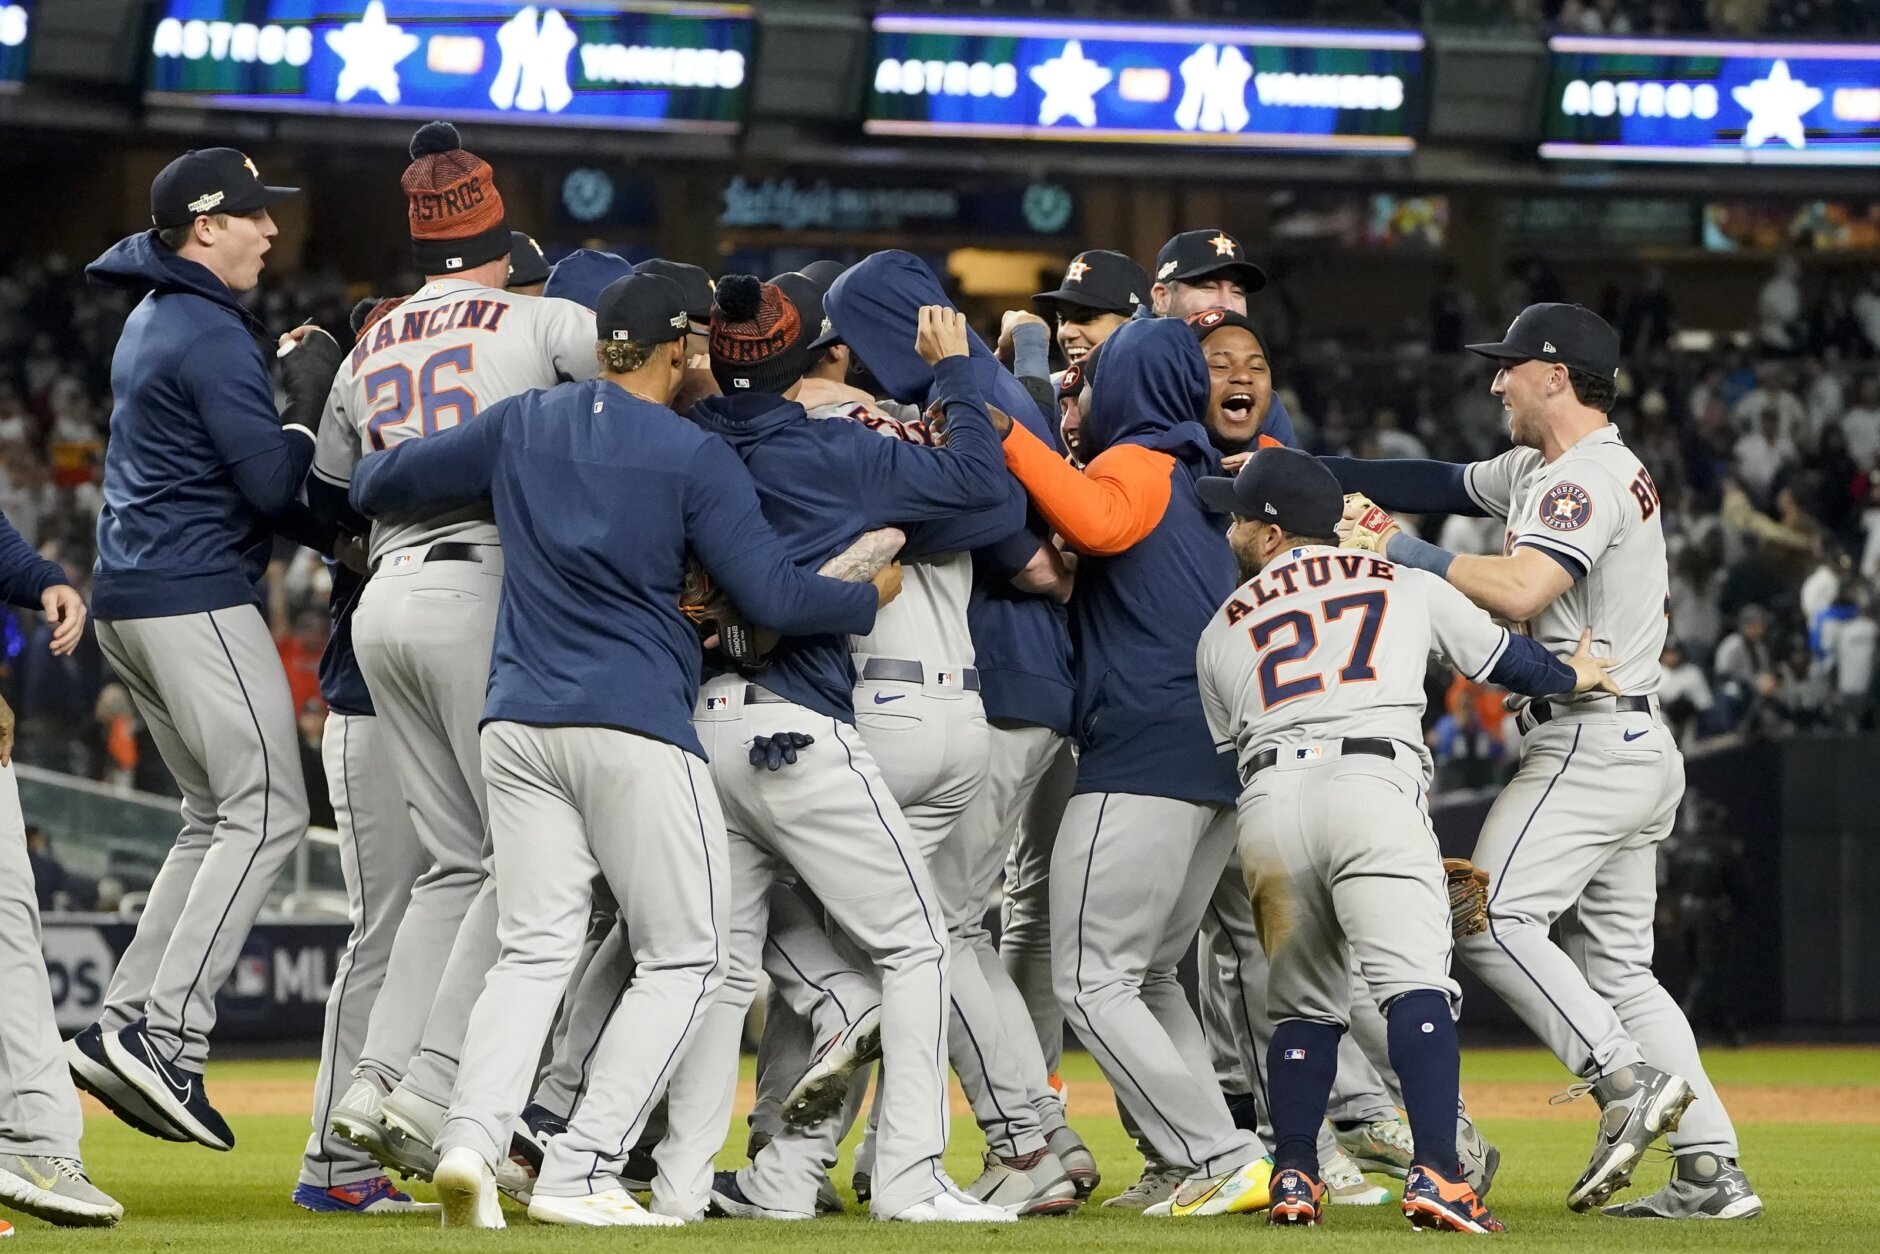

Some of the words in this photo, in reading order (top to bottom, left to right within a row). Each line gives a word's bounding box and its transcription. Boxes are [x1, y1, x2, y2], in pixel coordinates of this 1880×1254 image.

[154, 18, 311, 64] ASTROS
[875, 58, 1016, 97] ASTROS
[1562, 80, 1718, 119] ASTROS
[410, 176, 486, 221] ASTROS
[350, 299, 510, 379] MANCINI
[363, 342, 478, 453] 26
[1549, 486, 1589, 505] HOUSTON
[1544, 514, 1579, 530] ASTROS
[1223, 554, 1396, 629] ALTUVE
[1247, 588, 1390, 713] 27
[273, 945, 348, 1005] ML
